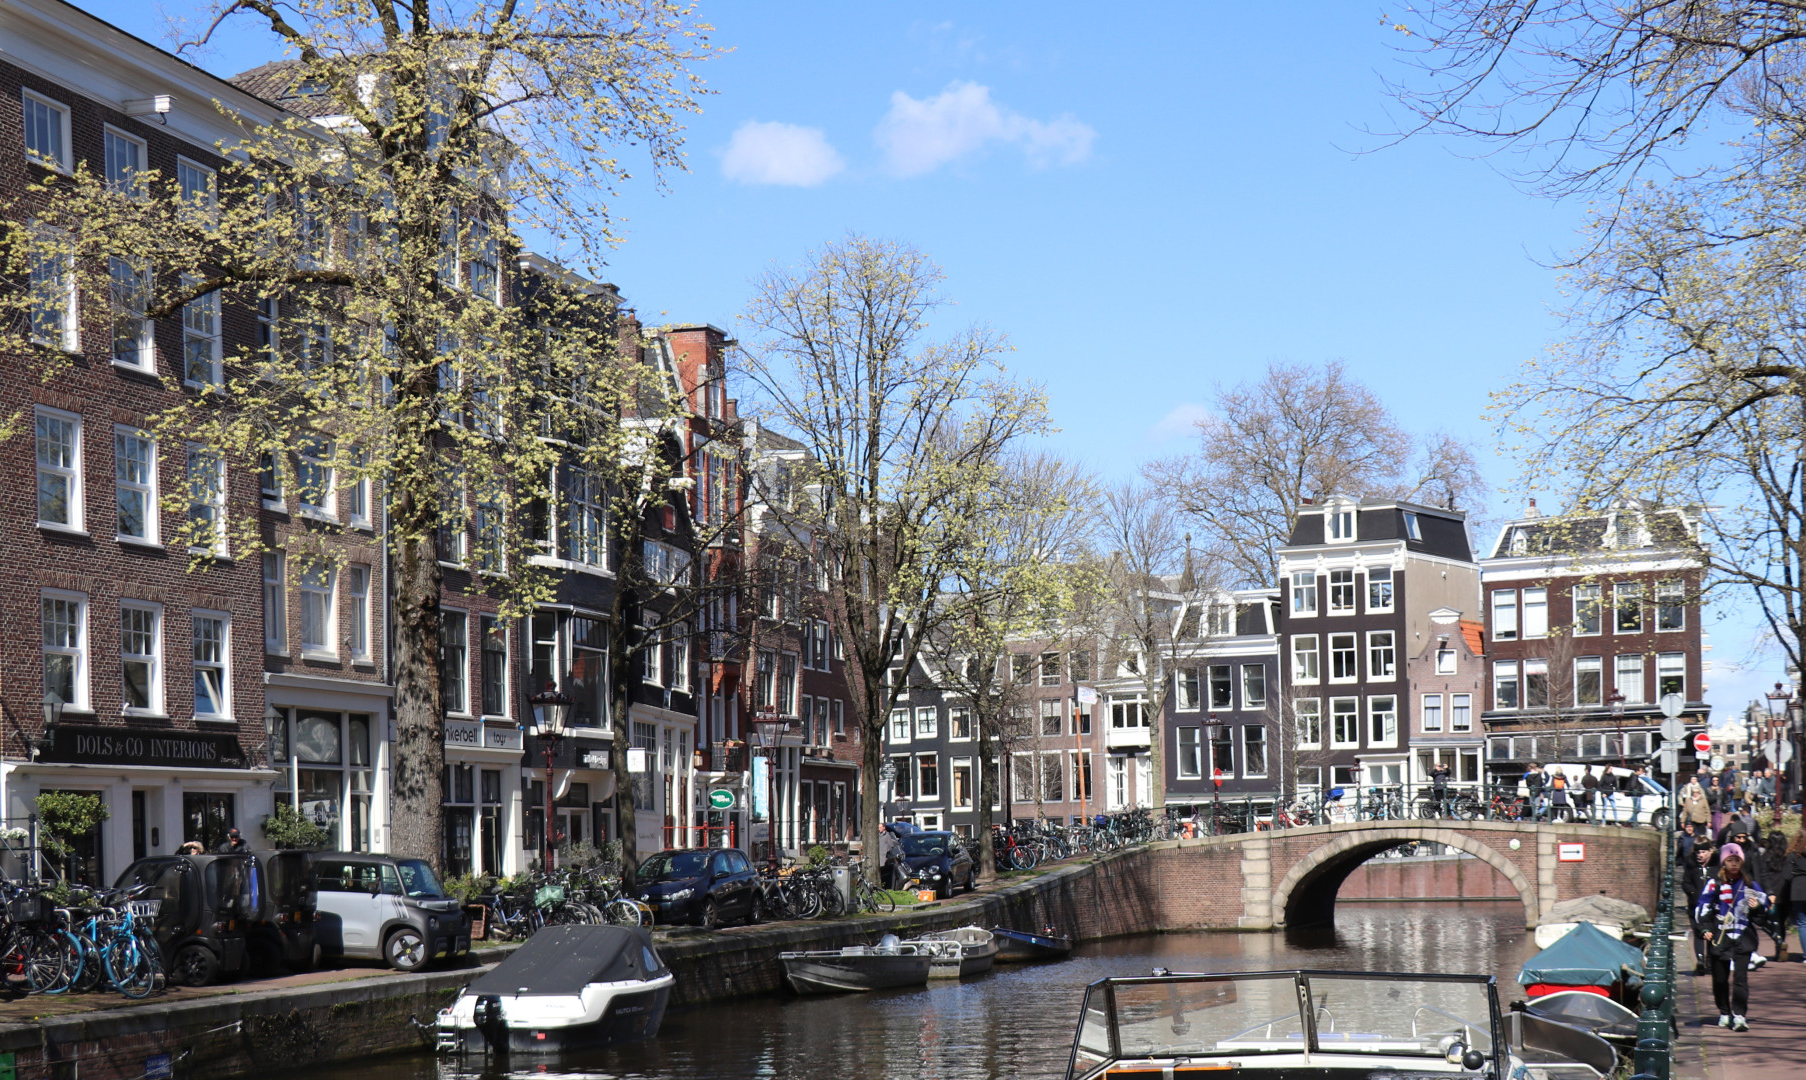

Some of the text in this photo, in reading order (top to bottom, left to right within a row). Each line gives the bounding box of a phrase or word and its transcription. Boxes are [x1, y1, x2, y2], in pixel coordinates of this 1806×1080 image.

[445, 725, 478, 743] nkerbell
[493, 731, 507, 746] toys
[76, 734, 113, 756] DOLS
[116, 741, 124, 756] &
[125, 737, 143, 757] CO
[150, 739, 216, 760] INTERIORS
